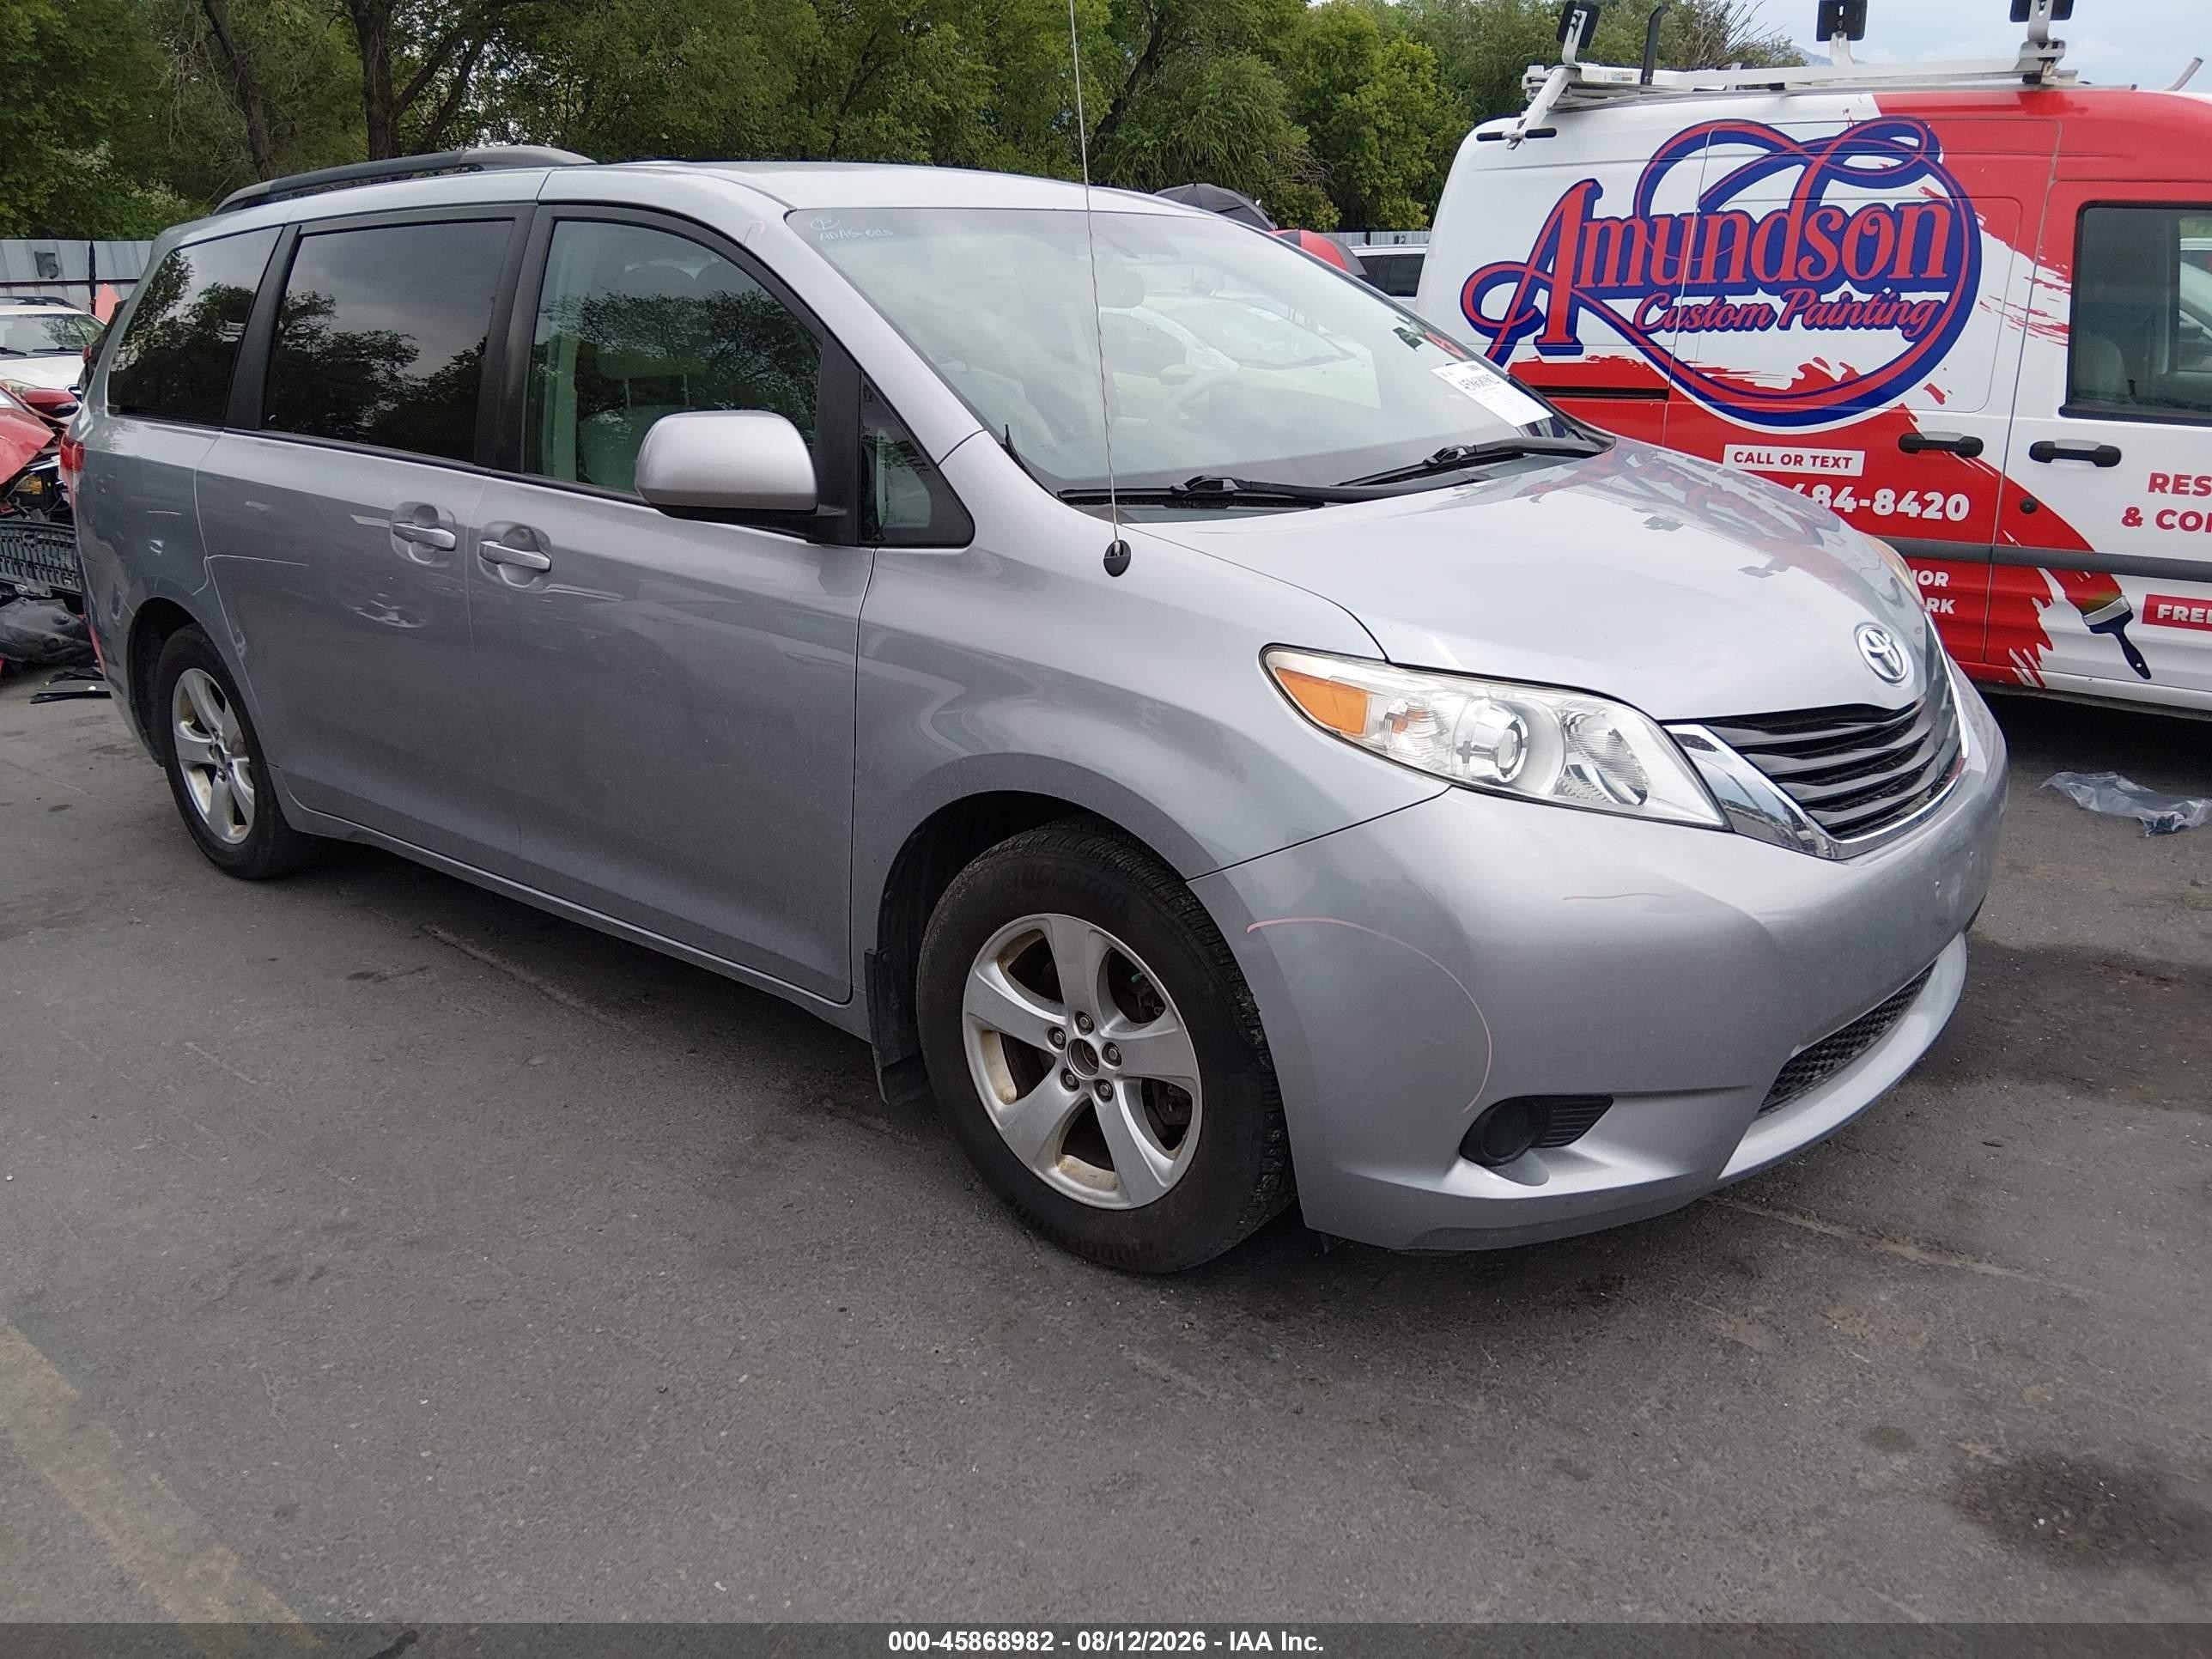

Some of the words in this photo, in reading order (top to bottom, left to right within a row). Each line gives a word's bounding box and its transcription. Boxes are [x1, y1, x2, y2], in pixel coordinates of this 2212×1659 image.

[1462, 177, 1954, 362] Amundson
[1634, 290, 1773, 331] Custom
[1777, 289, 1940, 338] Painting
[1734, 451, 1774, 465] CALL
[1780, 453, 1804, 466] OR
[1810, 455, 1853, 469] TEXT
[2148, 472, 2212, 496] RES
[2122, 506, 2143, 527] &
